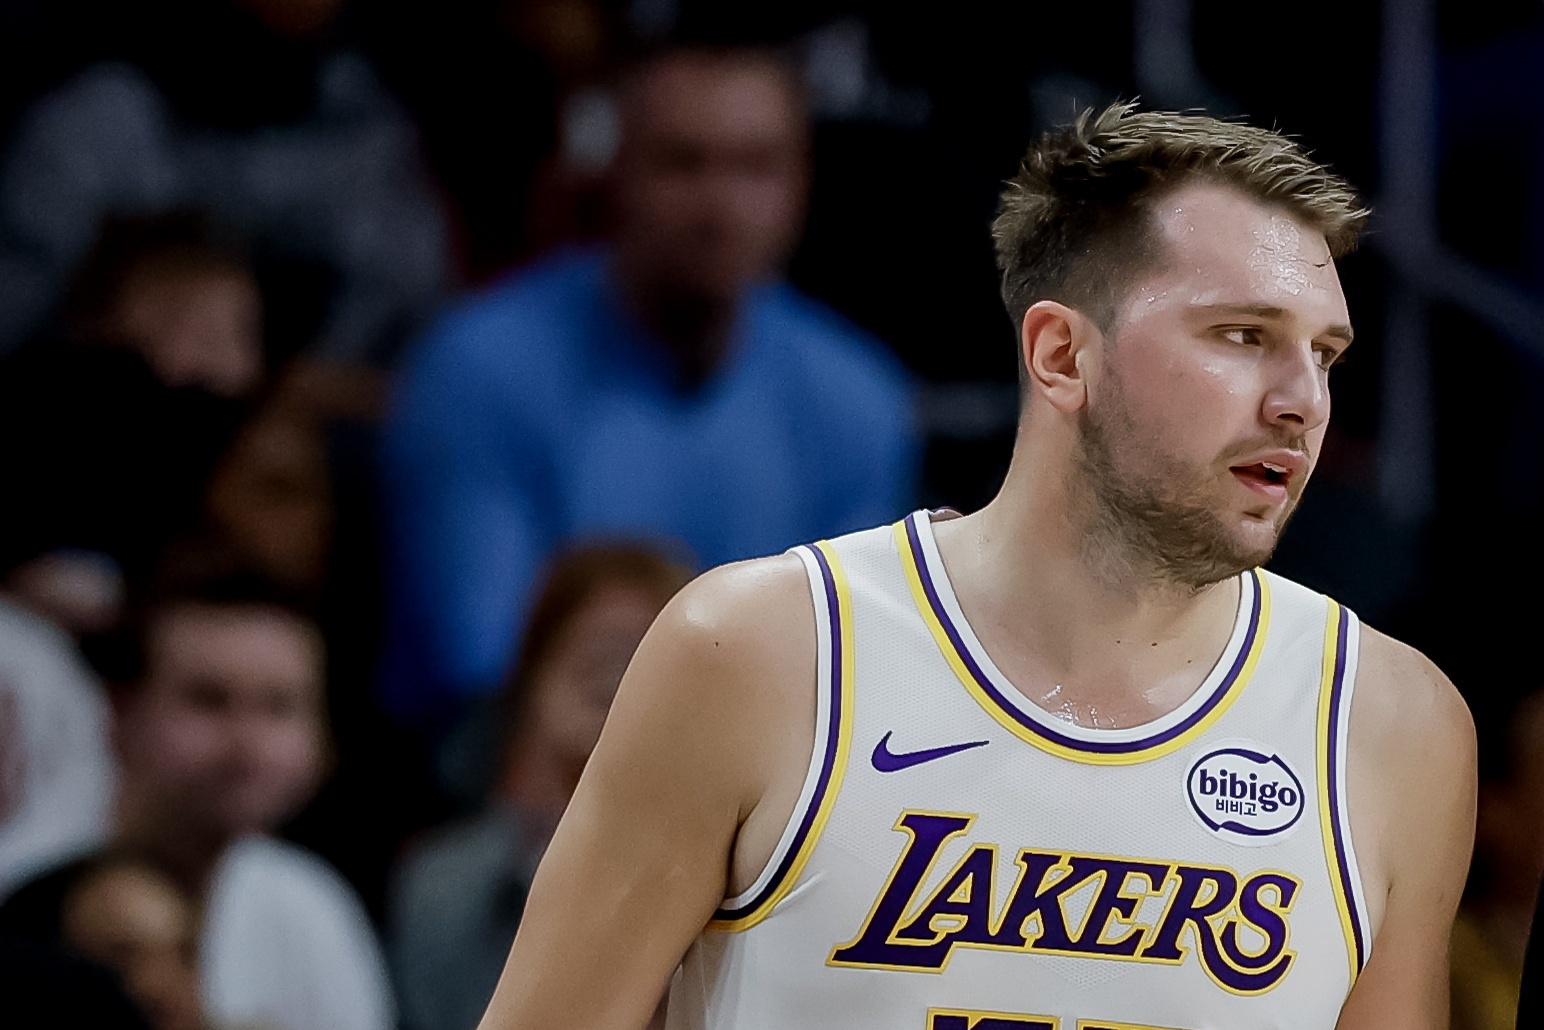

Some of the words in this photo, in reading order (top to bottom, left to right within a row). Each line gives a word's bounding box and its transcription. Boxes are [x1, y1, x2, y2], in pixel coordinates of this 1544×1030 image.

[1200, 769, 1297, 812] bibigo
[1215, 799, 1257, 816] 비비고
[825, 809, 1303, 996] LAKERS
